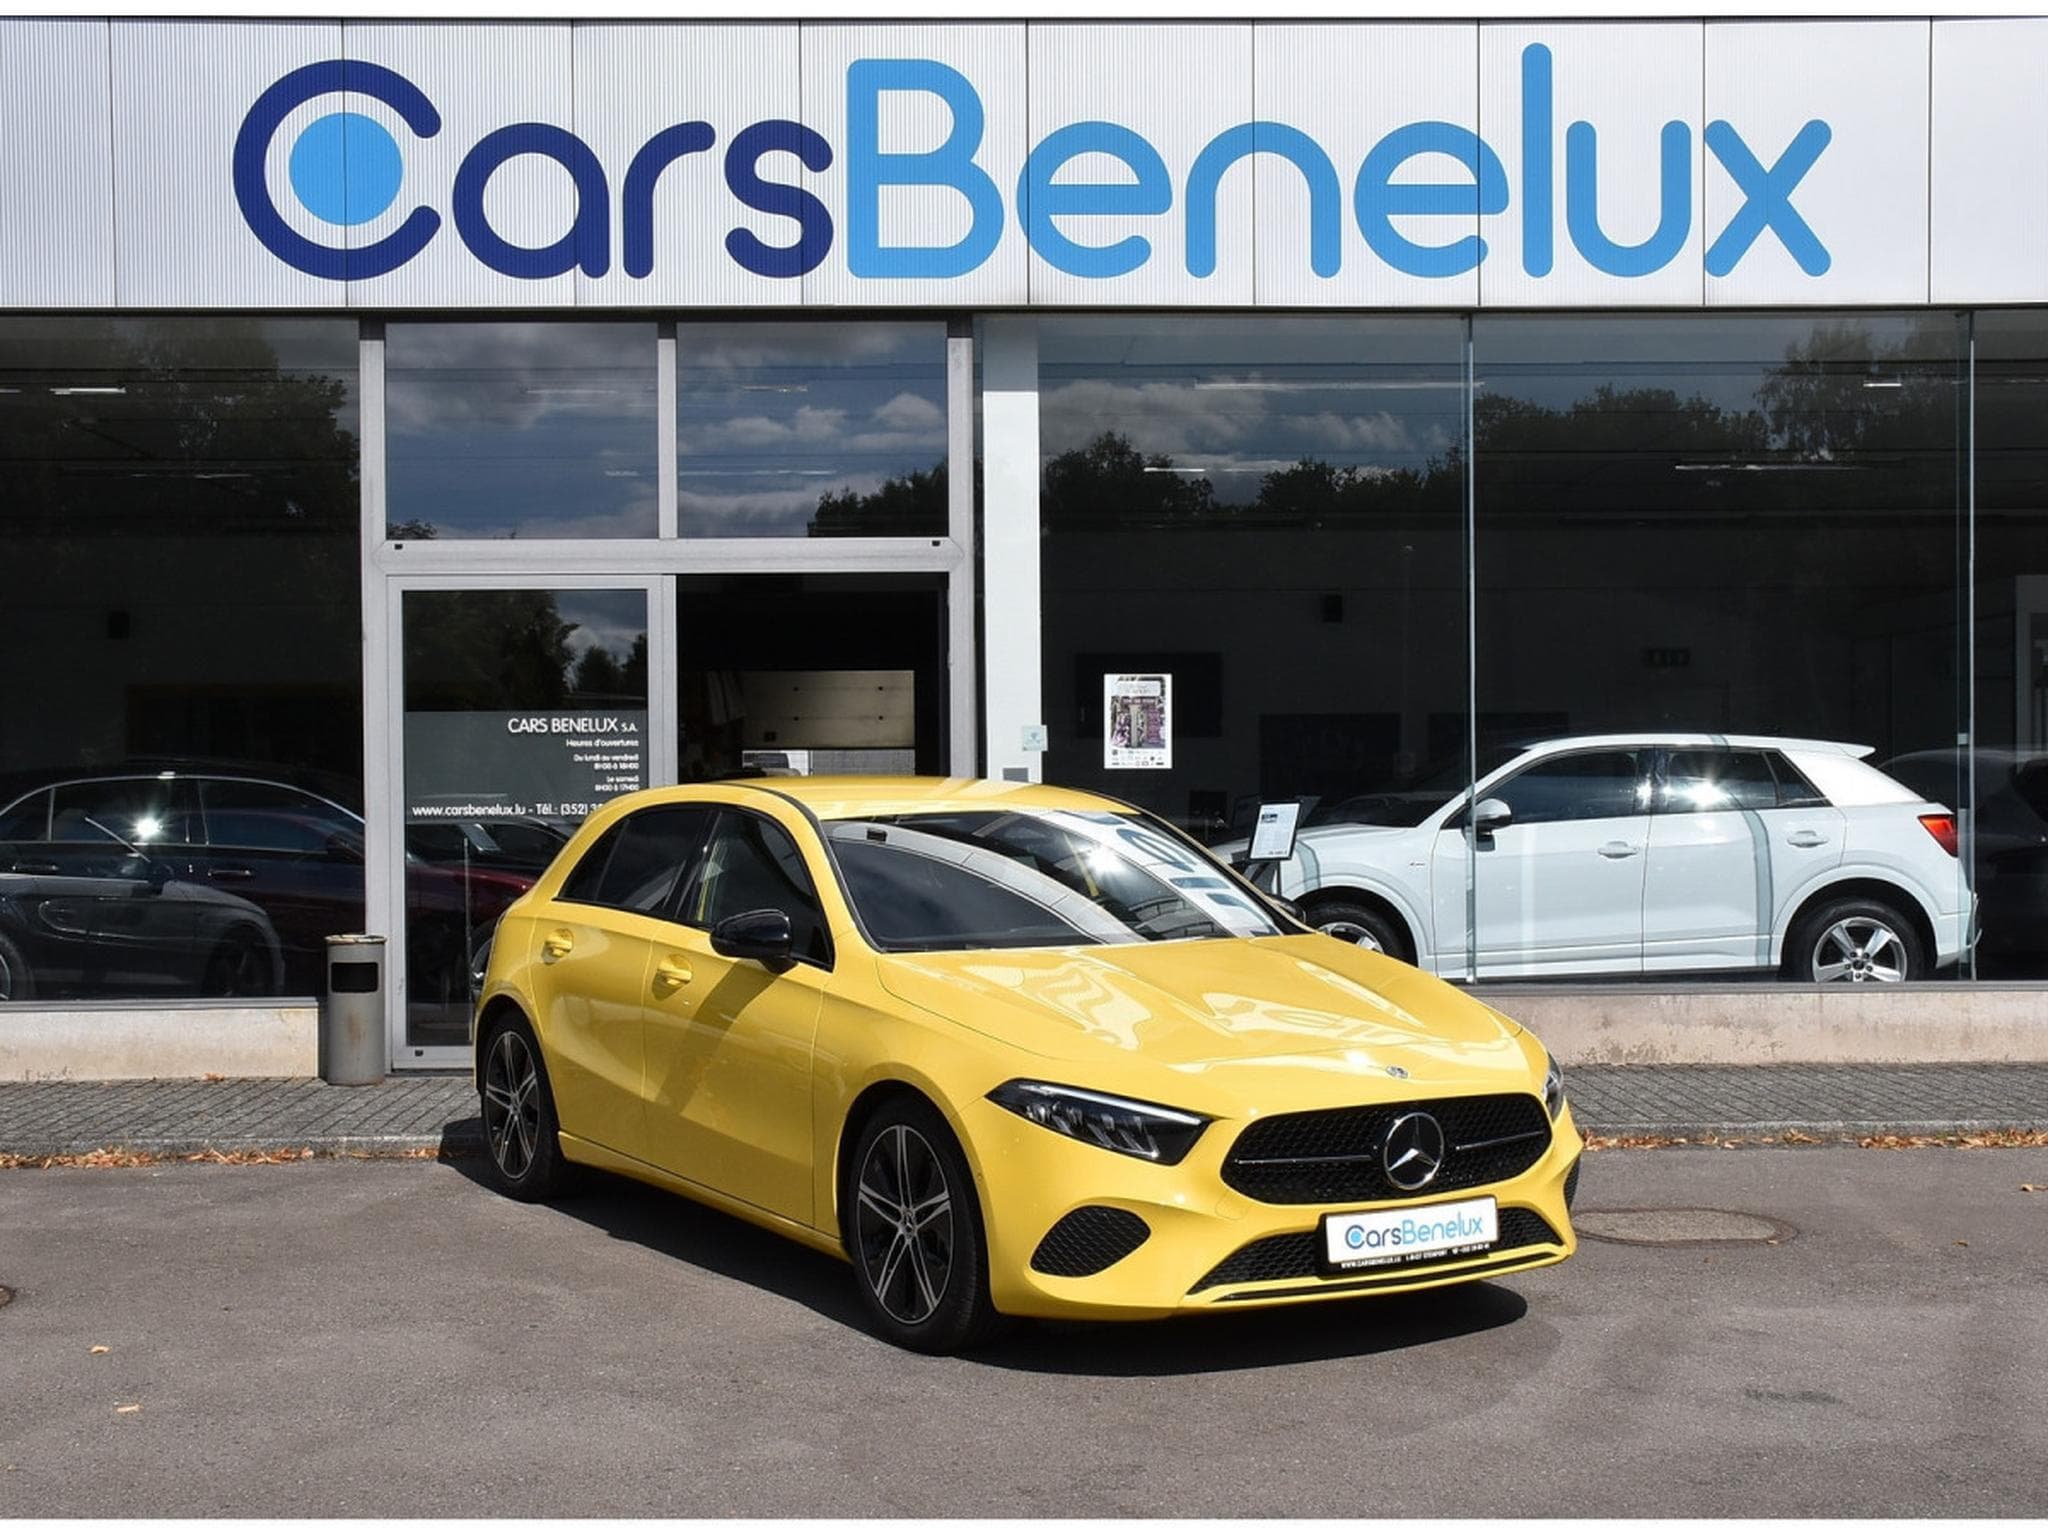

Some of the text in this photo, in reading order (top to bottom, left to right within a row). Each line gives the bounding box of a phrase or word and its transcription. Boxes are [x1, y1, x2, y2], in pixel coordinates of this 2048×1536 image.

[234, 44, 1832, 280] CarsBenelux
[507, 718, 548, 733] CARS
[551, 717, 618, 733] BENELUX
[566, 739, 593, 747] Heures
[412, 803, 526, 816] www.carsbenelux.lu
[560, 803, 588, 816] (352)
[1345, 1211, 1483, 1249] CarsBenelux
